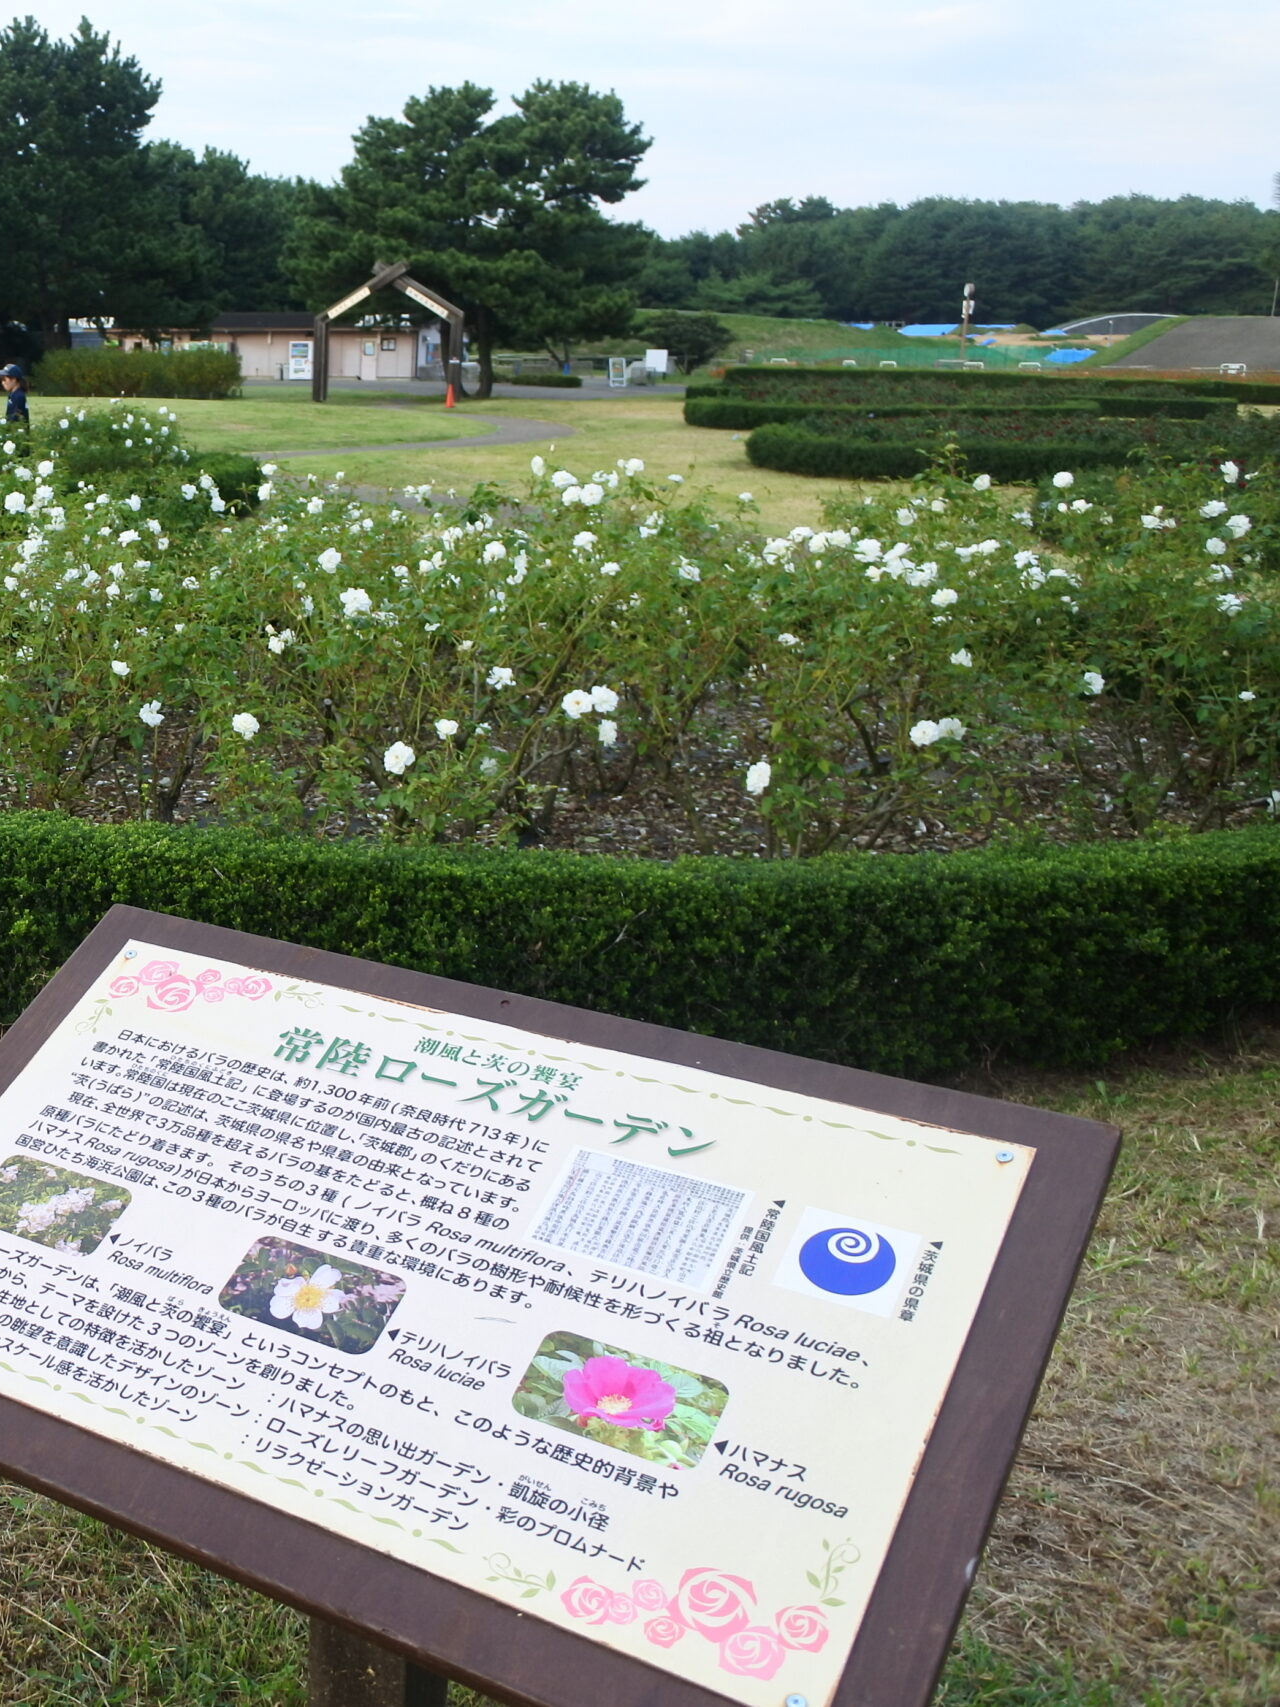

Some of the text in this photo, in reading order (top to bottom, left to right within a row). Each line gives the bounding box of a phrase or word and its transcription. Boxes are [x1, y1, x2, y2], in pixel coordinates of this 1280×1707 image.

[413, 1036, 583, 1092] 潮風と茨の饗宴
[273, 1026, 714, 1158] 常陸ローズガーデン
[28, 1119, 84, 1144] ハマナス
[83, 1136, 122, 1156] Rosa
[118, 1238, 174, 1262] ノイバラ
[738, 1208, 781, 1277] 常陸国風土記
[107, 1250, 214, 1295] Rosa multiflora
[424, 1220, 473, 1244] Rosa
[733, 1314, 790, 1341] Rosa
[898, 1250, 938, 1322] 茨城県の県章
[388, 1347, 486, 1391] Rosa luciae
[400, 1331, 512, 1378] テリハノイバラ
[517, 1474, 552, 1492] がいせん
[728, 1444, 807, 1483] ハマナス
[580, 1497, 607, 1512] こみち
[718, 1463, 849, 1519] Rosa rugosa
